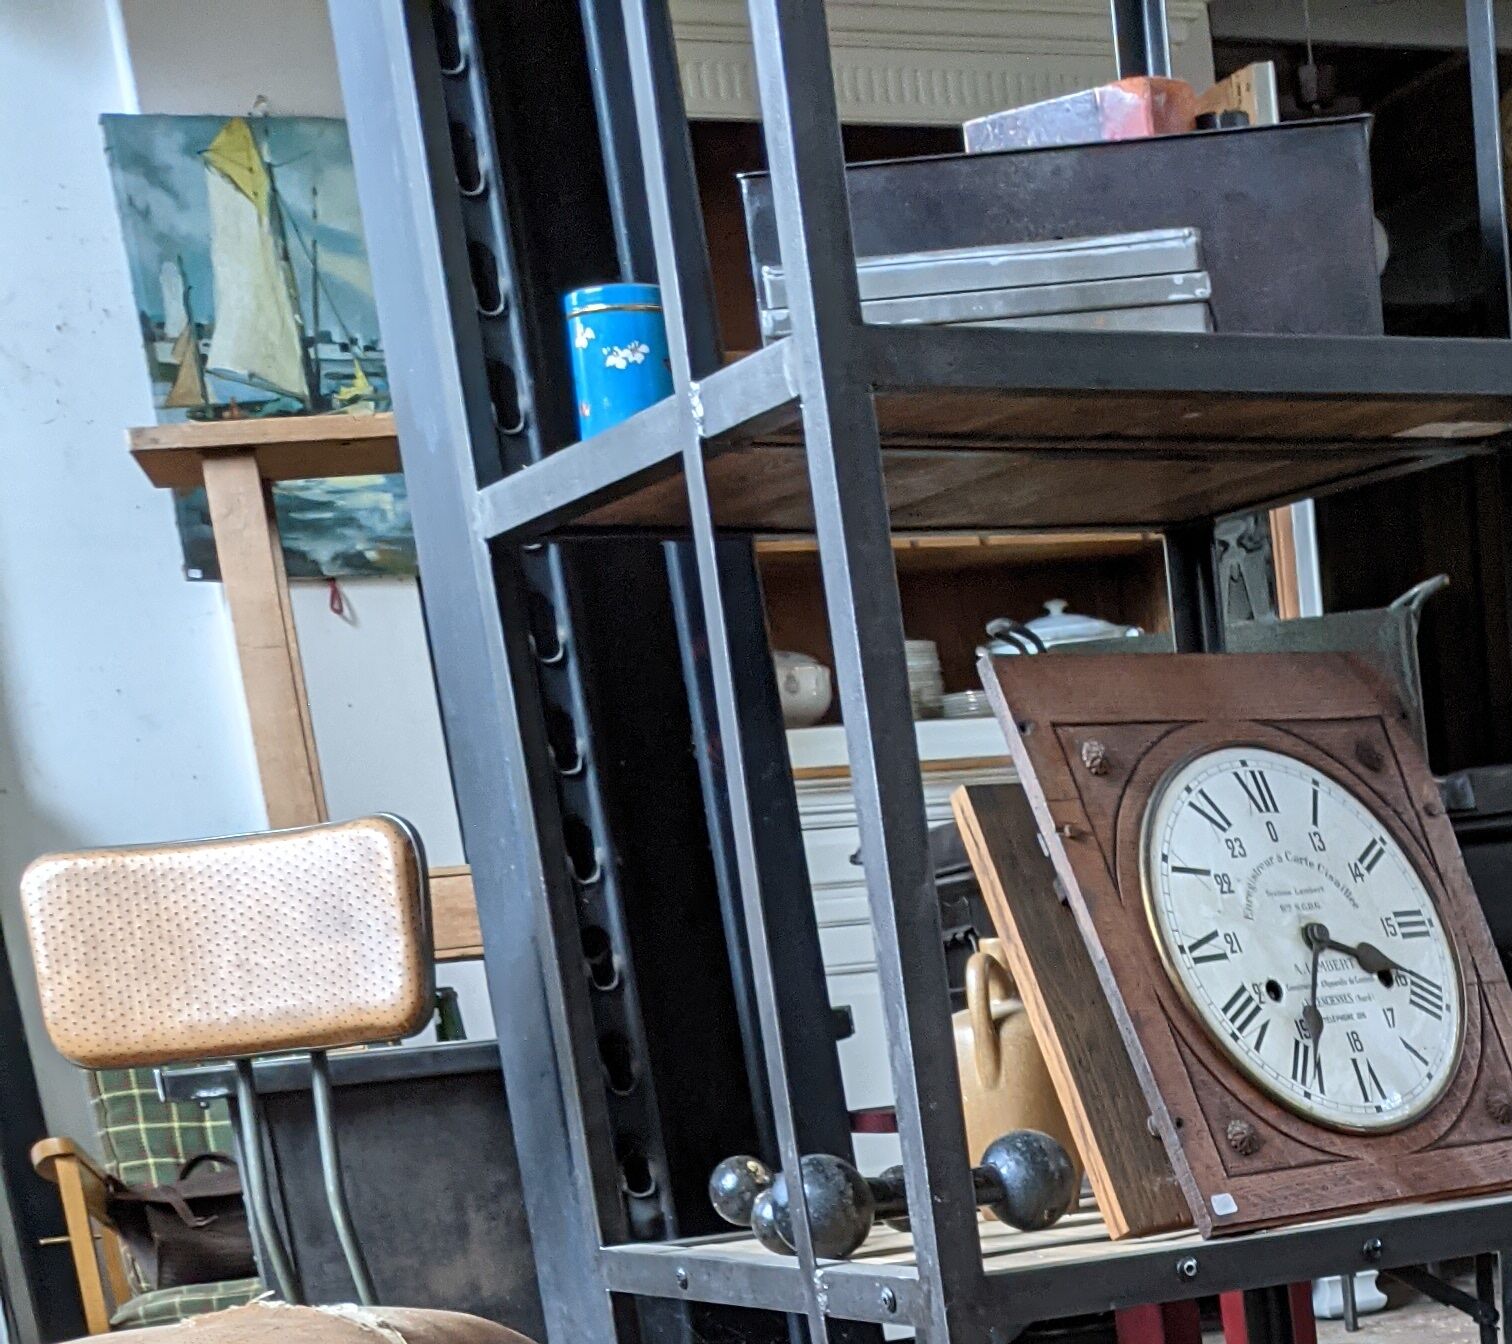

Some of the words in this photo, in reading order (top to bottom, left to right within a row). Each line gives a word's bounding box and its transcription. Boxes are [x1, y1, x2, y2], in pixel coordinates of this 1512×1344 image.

[1225, 837, 1247, 858] 23
[1308, 831, 1326, 852] 13
[1348, 862, 1364, 883] 14
[1214, 873, 1235, 895] 22
[1381, 917, 1397, 938] 15
[1224, 931, 1243, 954] 21
[1383, 1008, 1395, 1028] 17
[1346, 1031, 1364, 1053] 18
